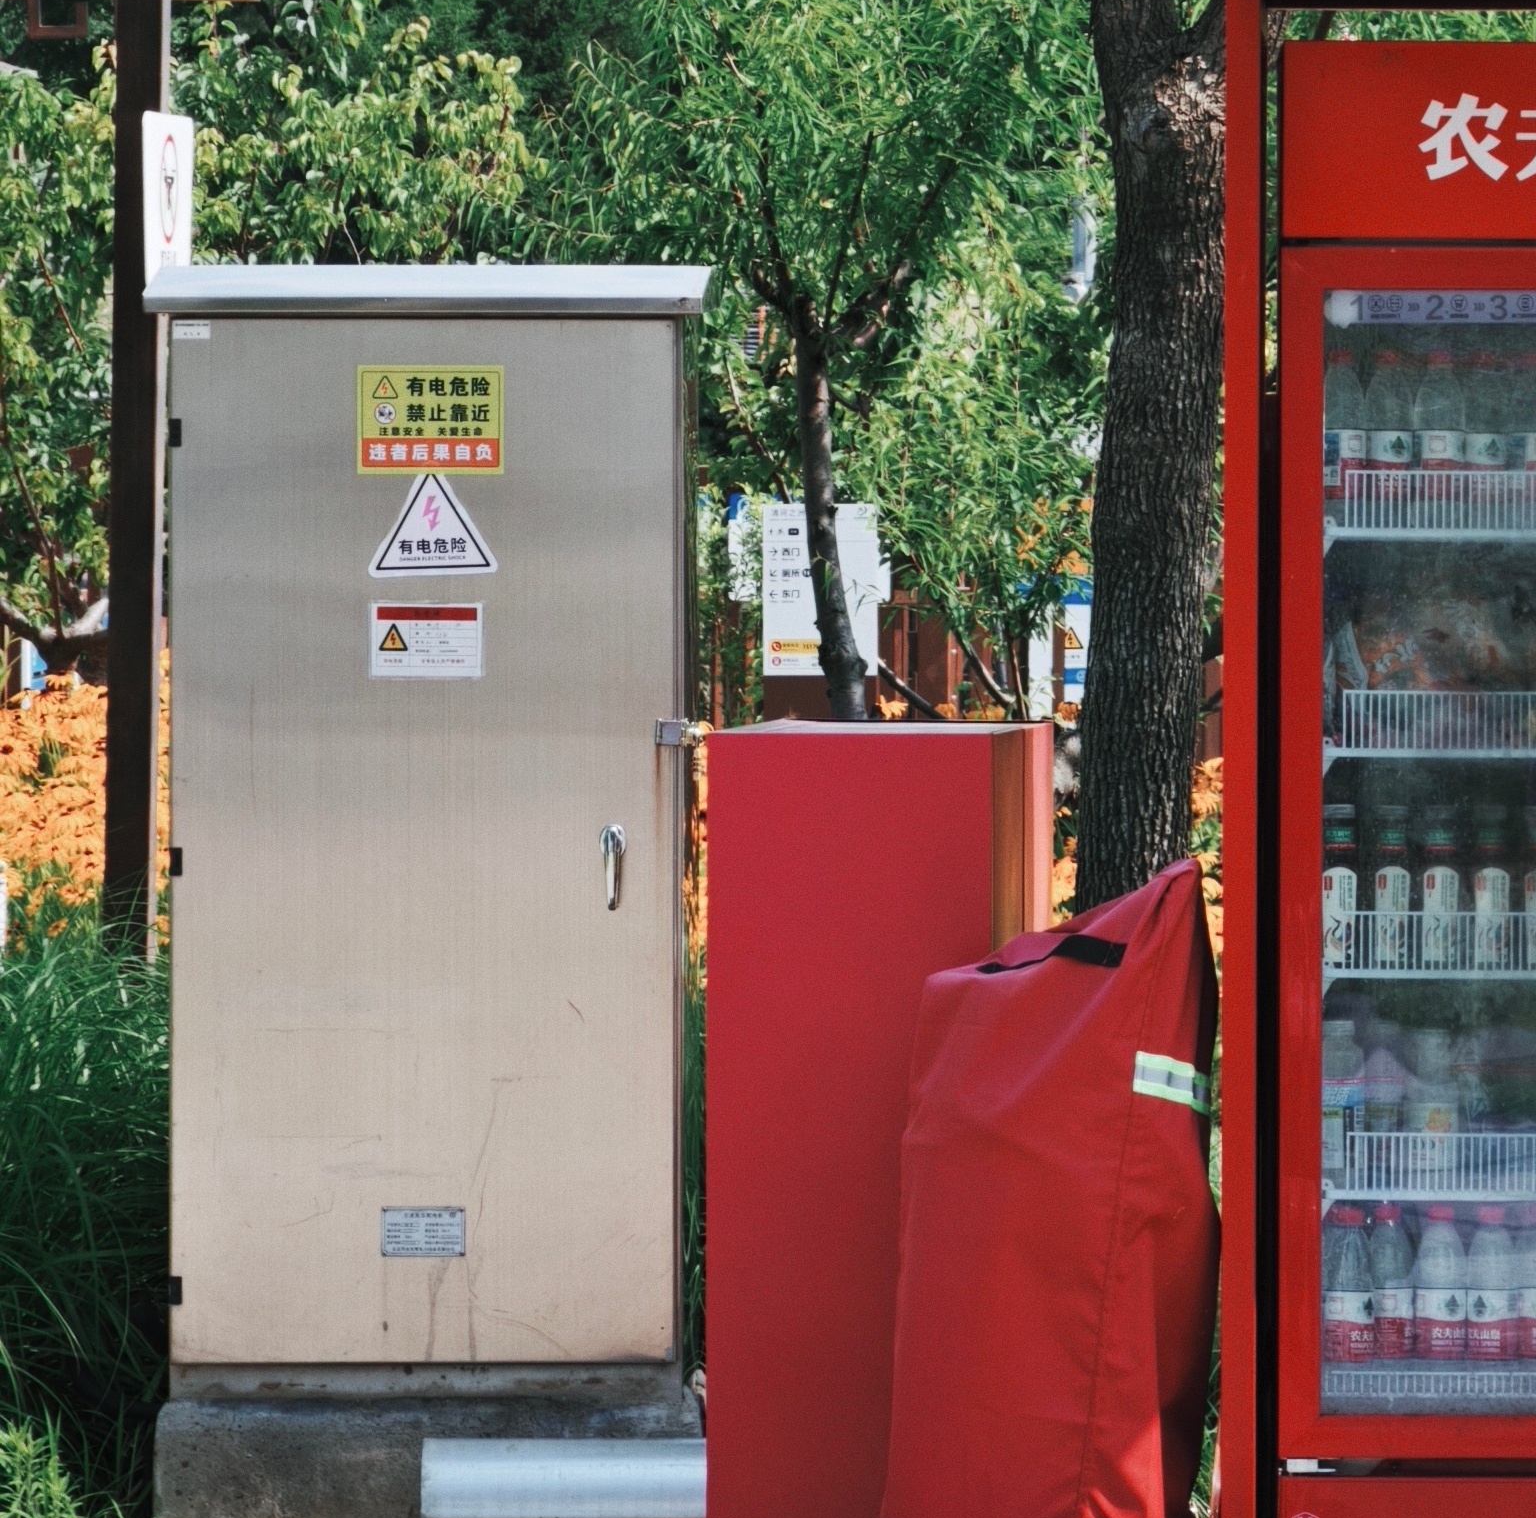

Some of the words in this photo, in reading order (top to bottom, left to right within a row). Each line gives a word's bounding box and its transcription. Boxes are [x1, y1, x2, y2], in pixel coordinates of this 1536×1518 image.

[406, 376, 491, 397] 有电危险
[406, 403, 490, 423] 禁止靠近
[379, 426, 425, 437] 注意安全
[437, 426, 483, 437] 关爱生命
[369, 443, 493, 462] 违者后果自负
[398, 537, 468, 555] 有电危险
